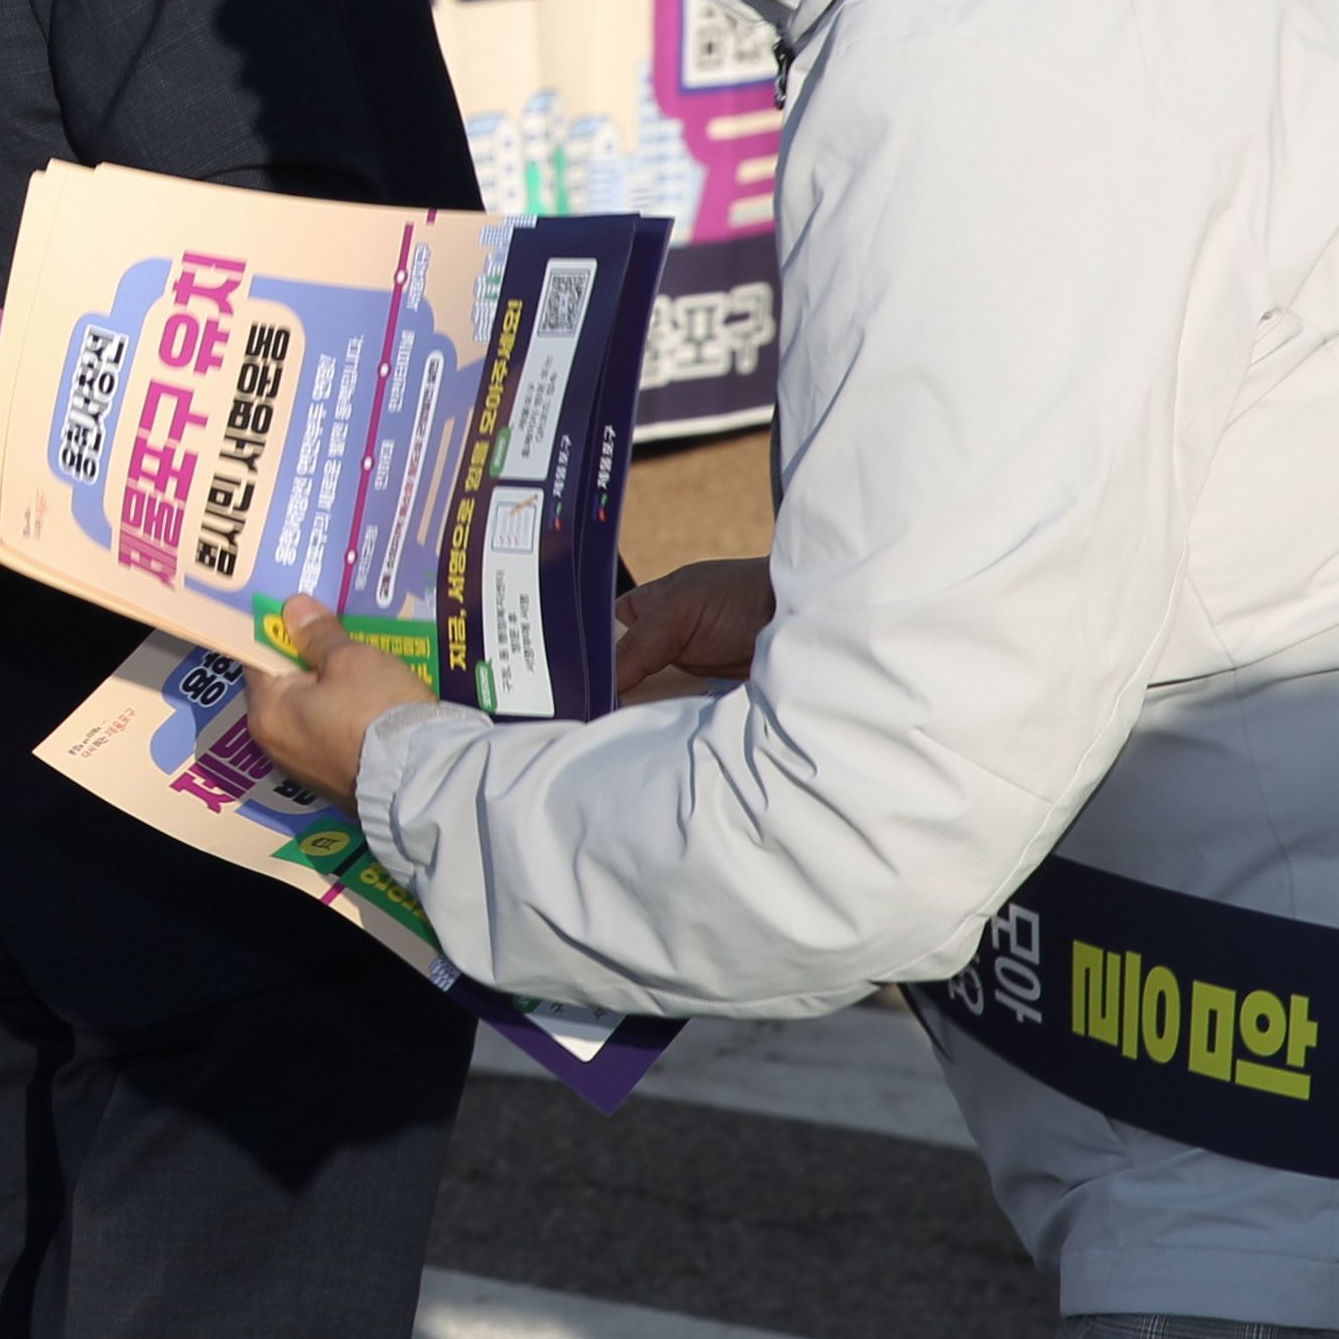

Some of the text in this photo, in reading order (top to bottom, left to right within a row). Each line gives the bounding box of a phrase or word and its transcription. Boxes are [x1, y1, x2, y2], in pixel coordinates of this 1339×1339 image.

[58, 323, 130, 485] 용현서창선
[118, 251, 247, 591] 제물포구 유치
[479, 299, 523, 435] 모아주세요!
[195, 321, 290, 578] 범시민 서명운동
[465, 440, 490, 492] 힘을
[448, 497, 476, 604] 서명으로
[448, 608, 468, 671] 지금,
[169, 714, 274, 814] 제물
[1070, 938, 1319, 1101] 힘을
